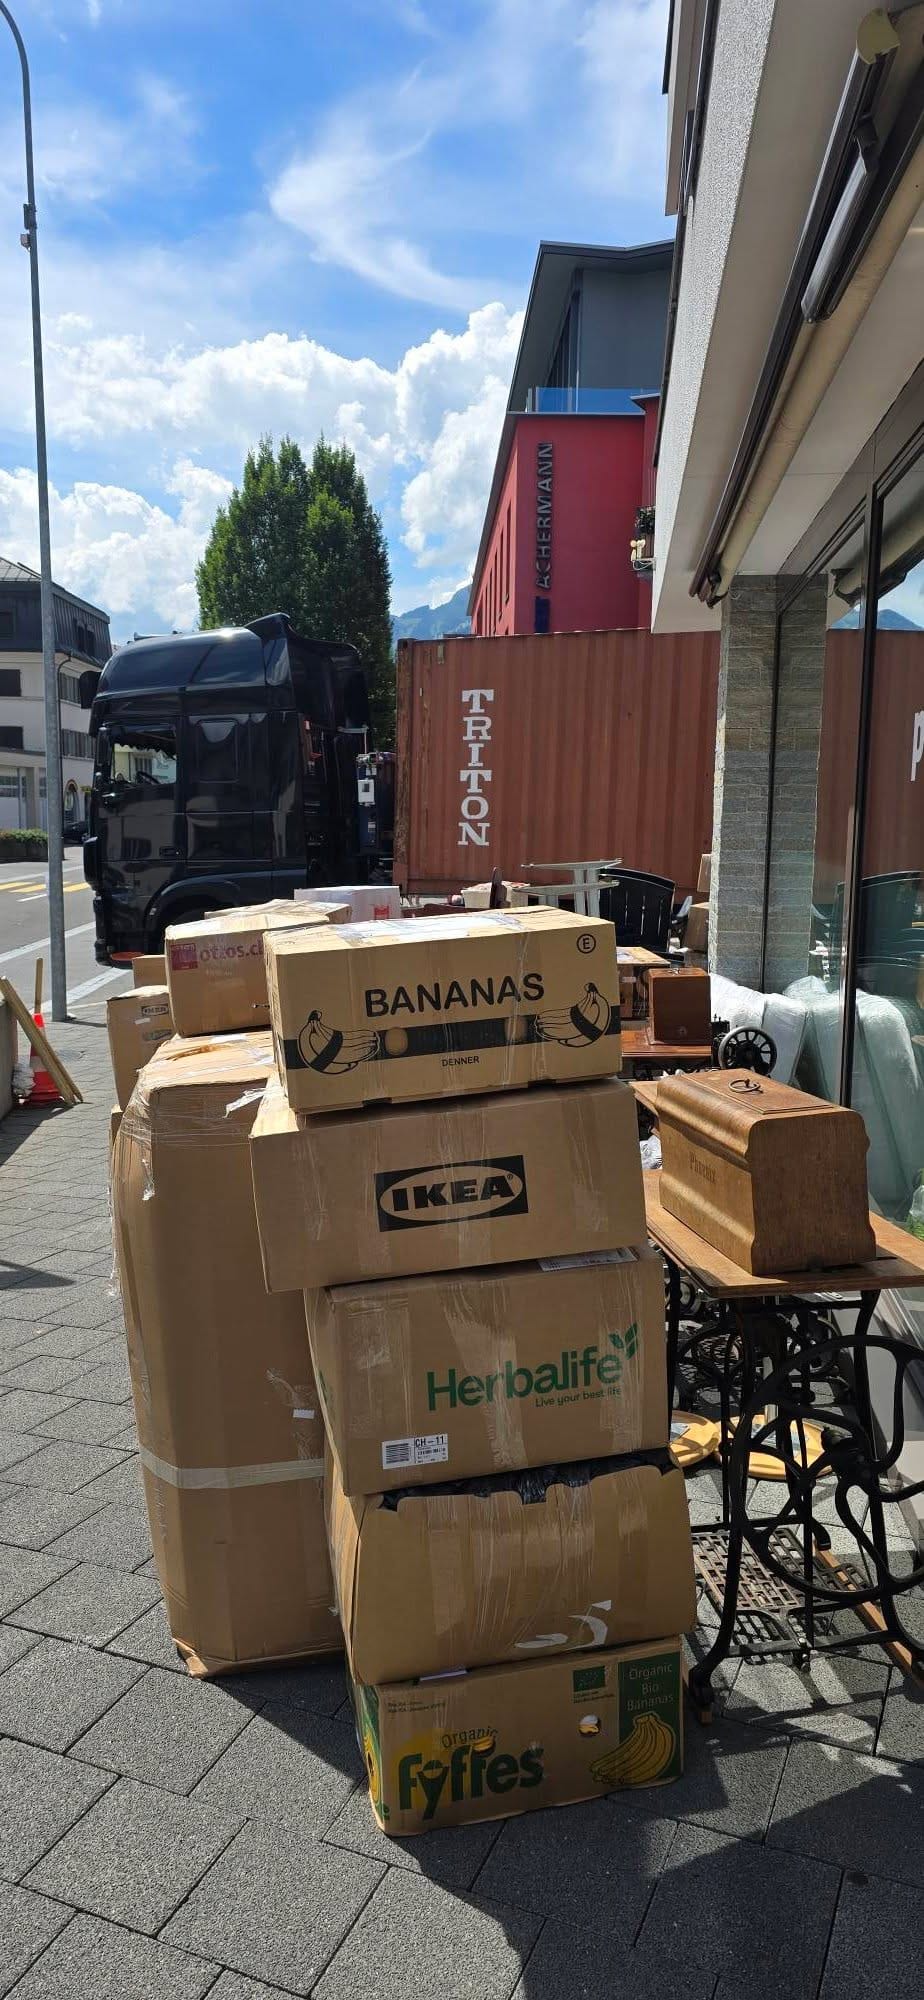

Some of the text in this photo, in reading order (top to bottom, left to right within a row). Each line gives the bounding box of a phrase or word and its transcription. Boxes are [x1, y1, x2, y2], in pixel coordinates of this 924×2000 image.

[536, 442, 553, 590] ACHERMANN
[458, 689, 494, 846] TRITON
[365, 973, 545, 1018] BANANAS
[441, 1055, 480, 1067] DENNER
[392, 1175, 515, 1212] IKEA
[427, 1345, 623, 1411] Herbalife
[535, 1385, 621, 1407] Live your best life
[628, 1664, 673, 1680] Organic
[642, 1681, 659, 1695] Bio
[627, 1695, 674, 1711] Bananas
[441, 1725, 499, 1749] Organic
